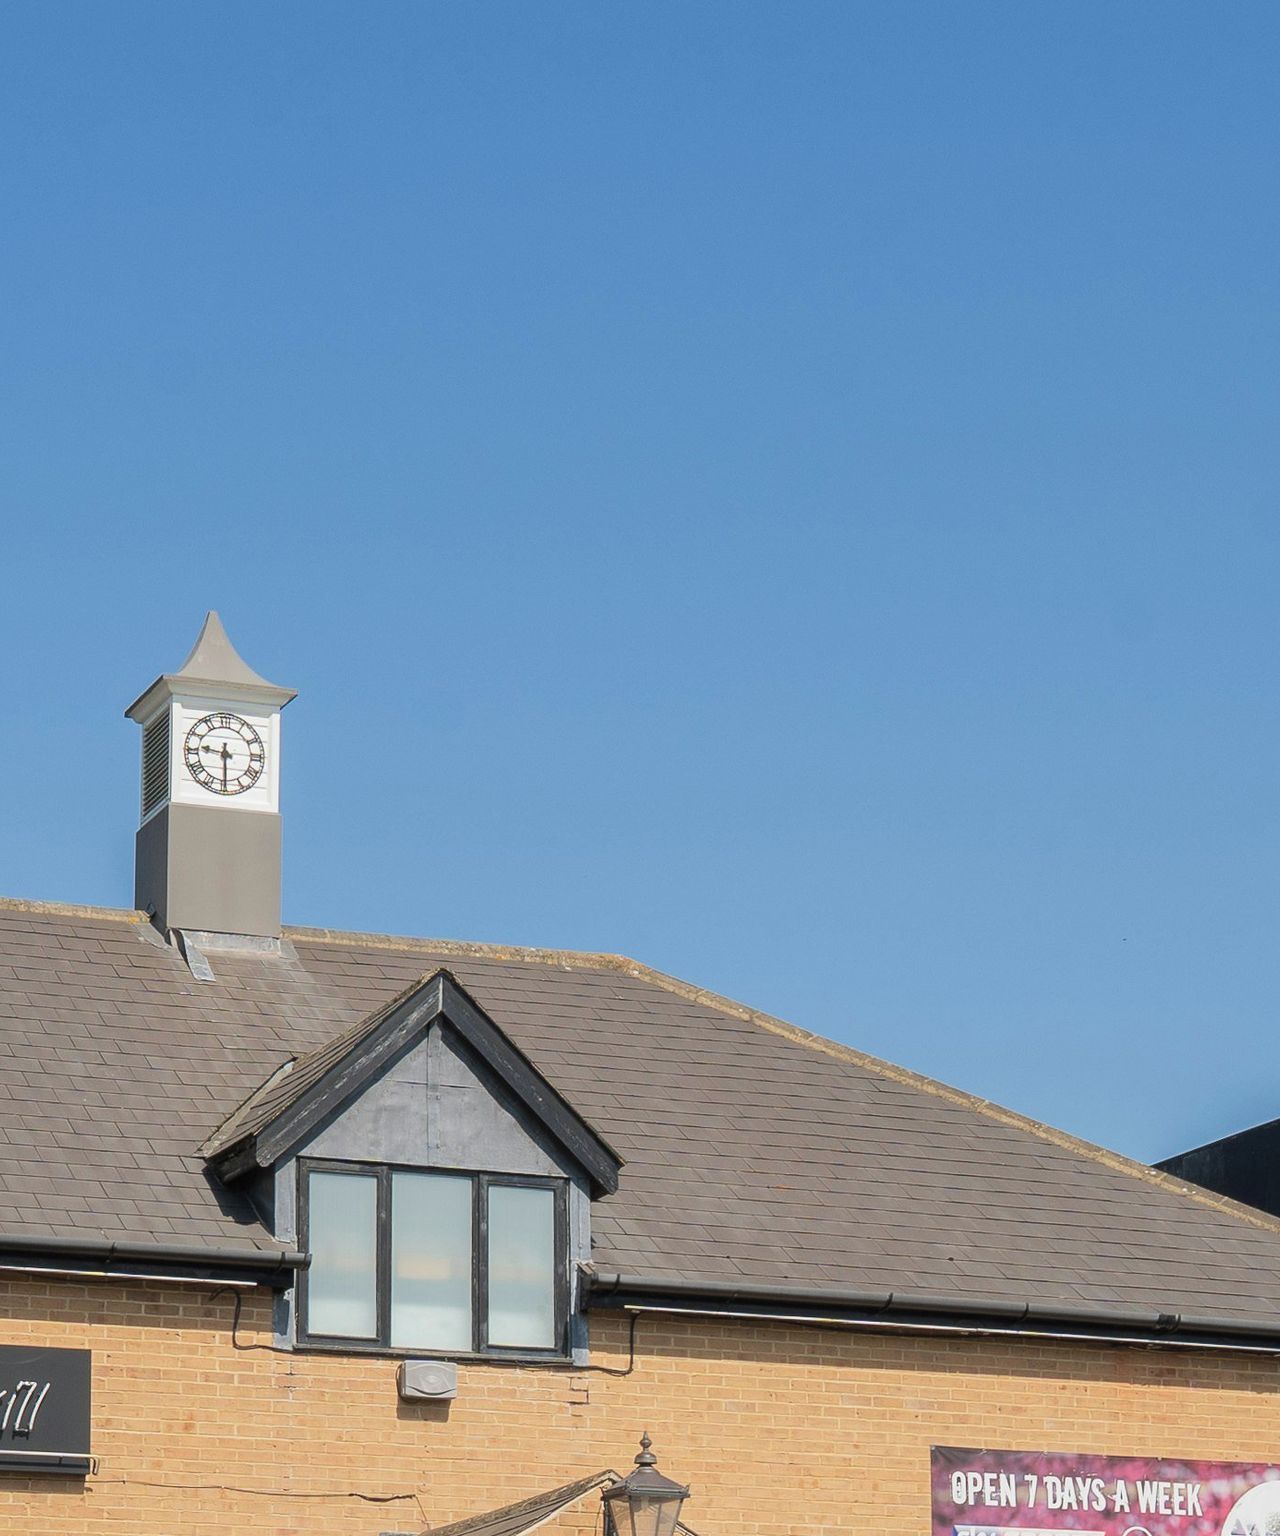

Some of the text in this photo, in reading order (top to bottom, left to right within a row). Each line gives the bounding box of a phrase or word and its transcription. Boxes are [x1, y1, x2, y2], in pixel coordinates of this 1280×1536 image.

[951, 1470, 1203, 1517] OPEN 7 DAYS A WEEK
